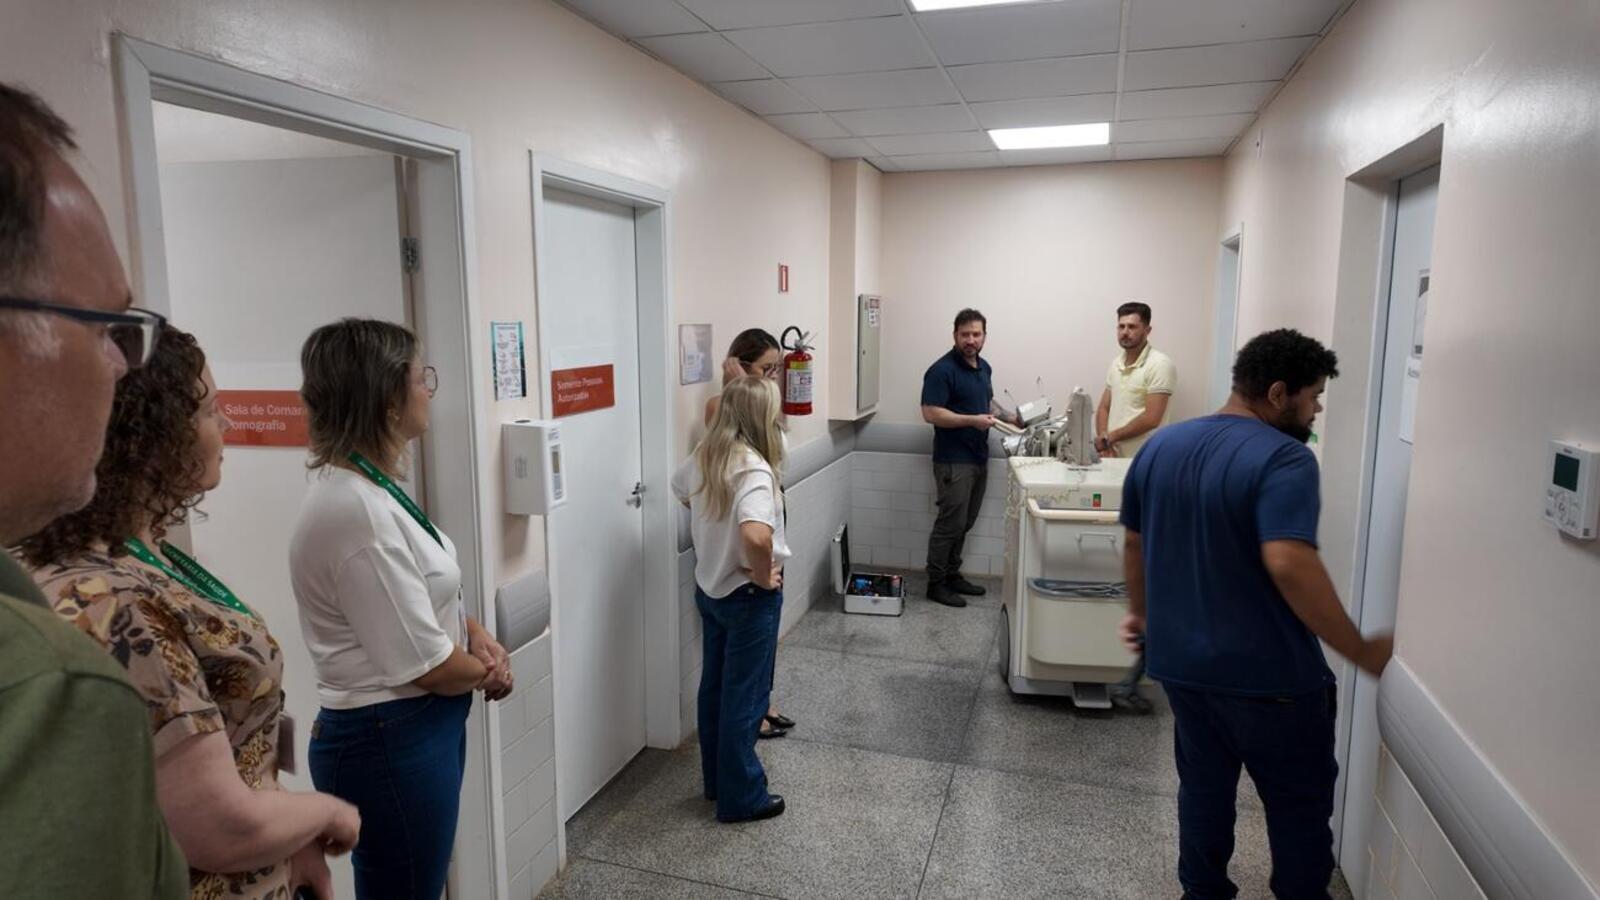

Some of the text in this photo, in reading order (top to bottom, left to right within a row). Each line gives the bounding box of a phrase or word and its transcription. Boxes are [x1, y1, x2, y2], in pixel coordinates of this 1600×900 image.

[225, 403, 249, 415] Sala
[250, 404, 264, 415] de
[230, 420, 286, 432] omografia
